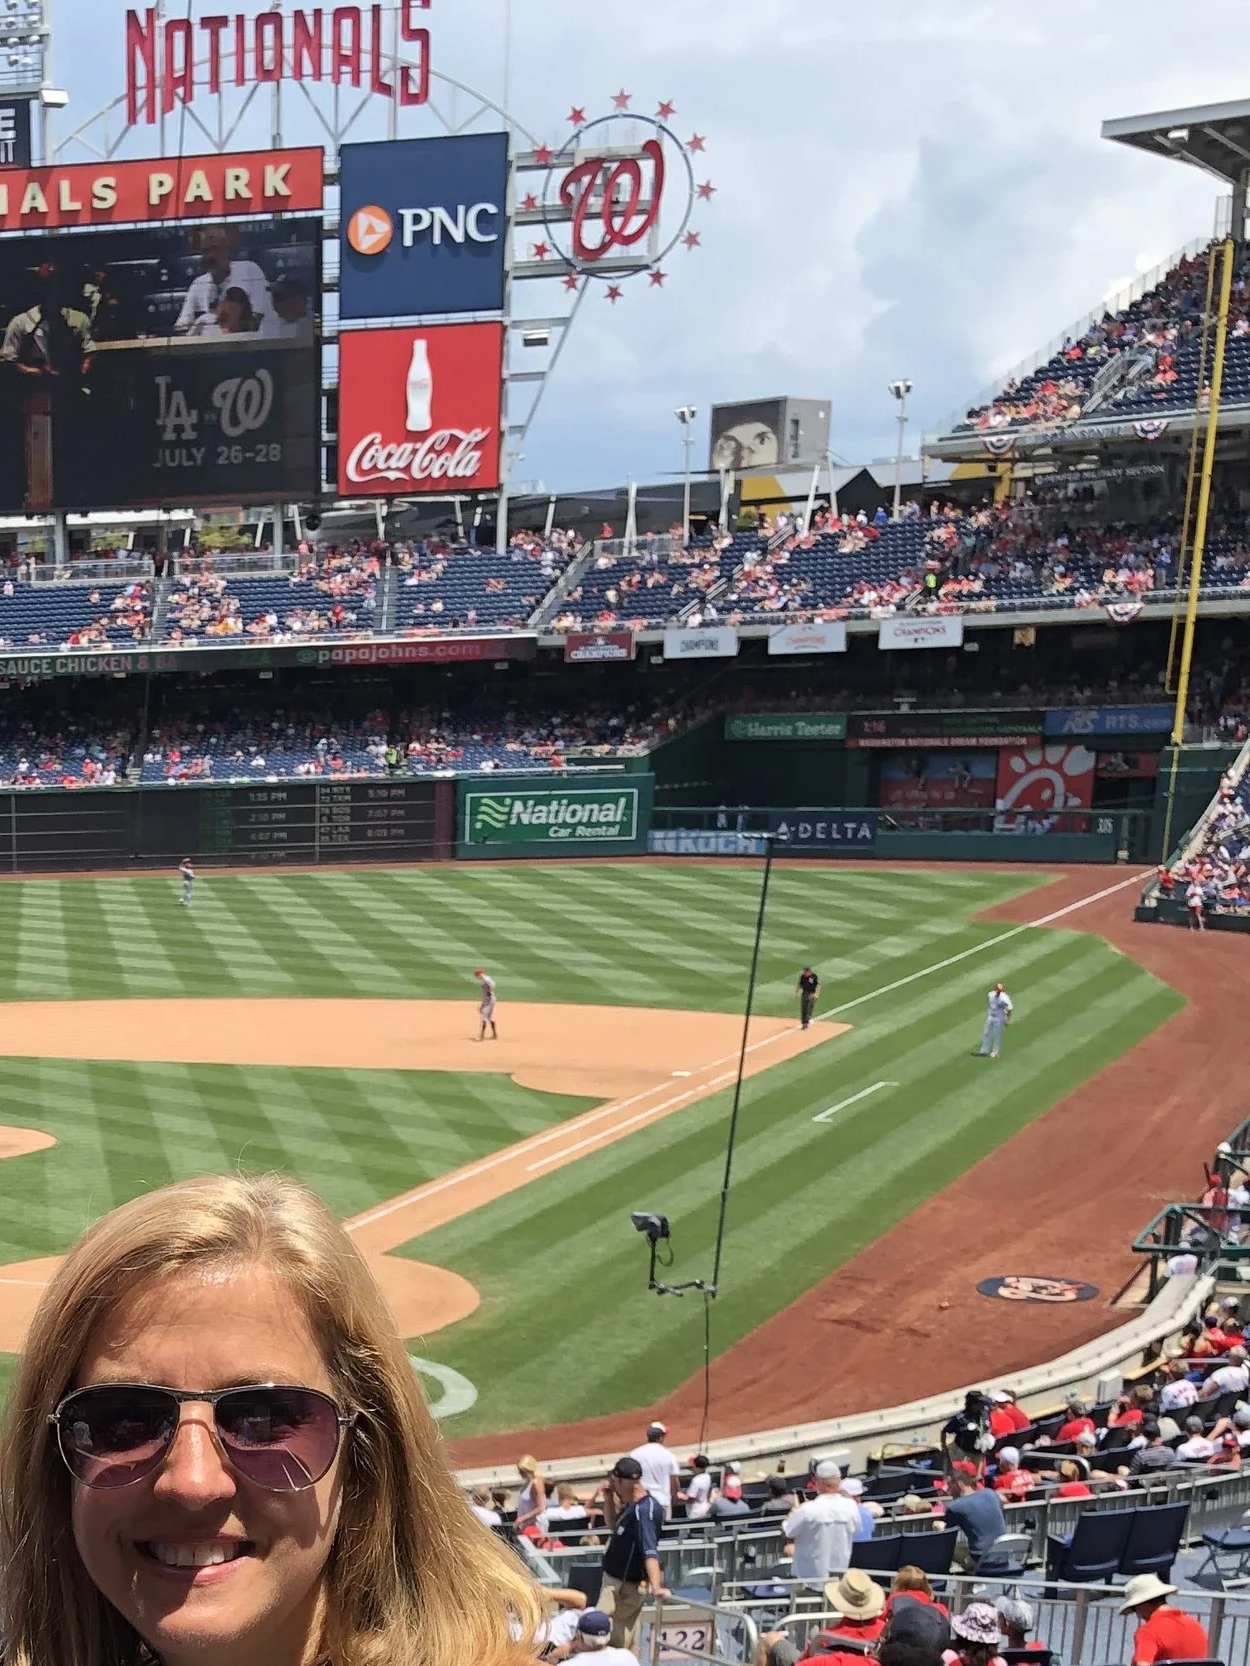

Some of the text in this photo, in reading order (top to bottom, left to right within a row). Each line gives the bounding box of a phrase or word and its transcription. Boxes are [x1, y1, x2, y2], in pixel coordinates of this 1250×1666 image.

[125, 0, 431, 126] NATIONALS
[148, 163, 293, 205] PARK
[398, 202, 499, 247] PNC
[152, 443, 282, 468] JULY 26-28
[346, 427, 491, 482] Coca-Cola
[55, 655, 132, 673] CHICKEN
[509, 797, 626, 825] National
[549, 825, 620, 837] Car Rental
[800, 823, 871, 840] DELTA
[661, 1630, 705, 1651] 122
